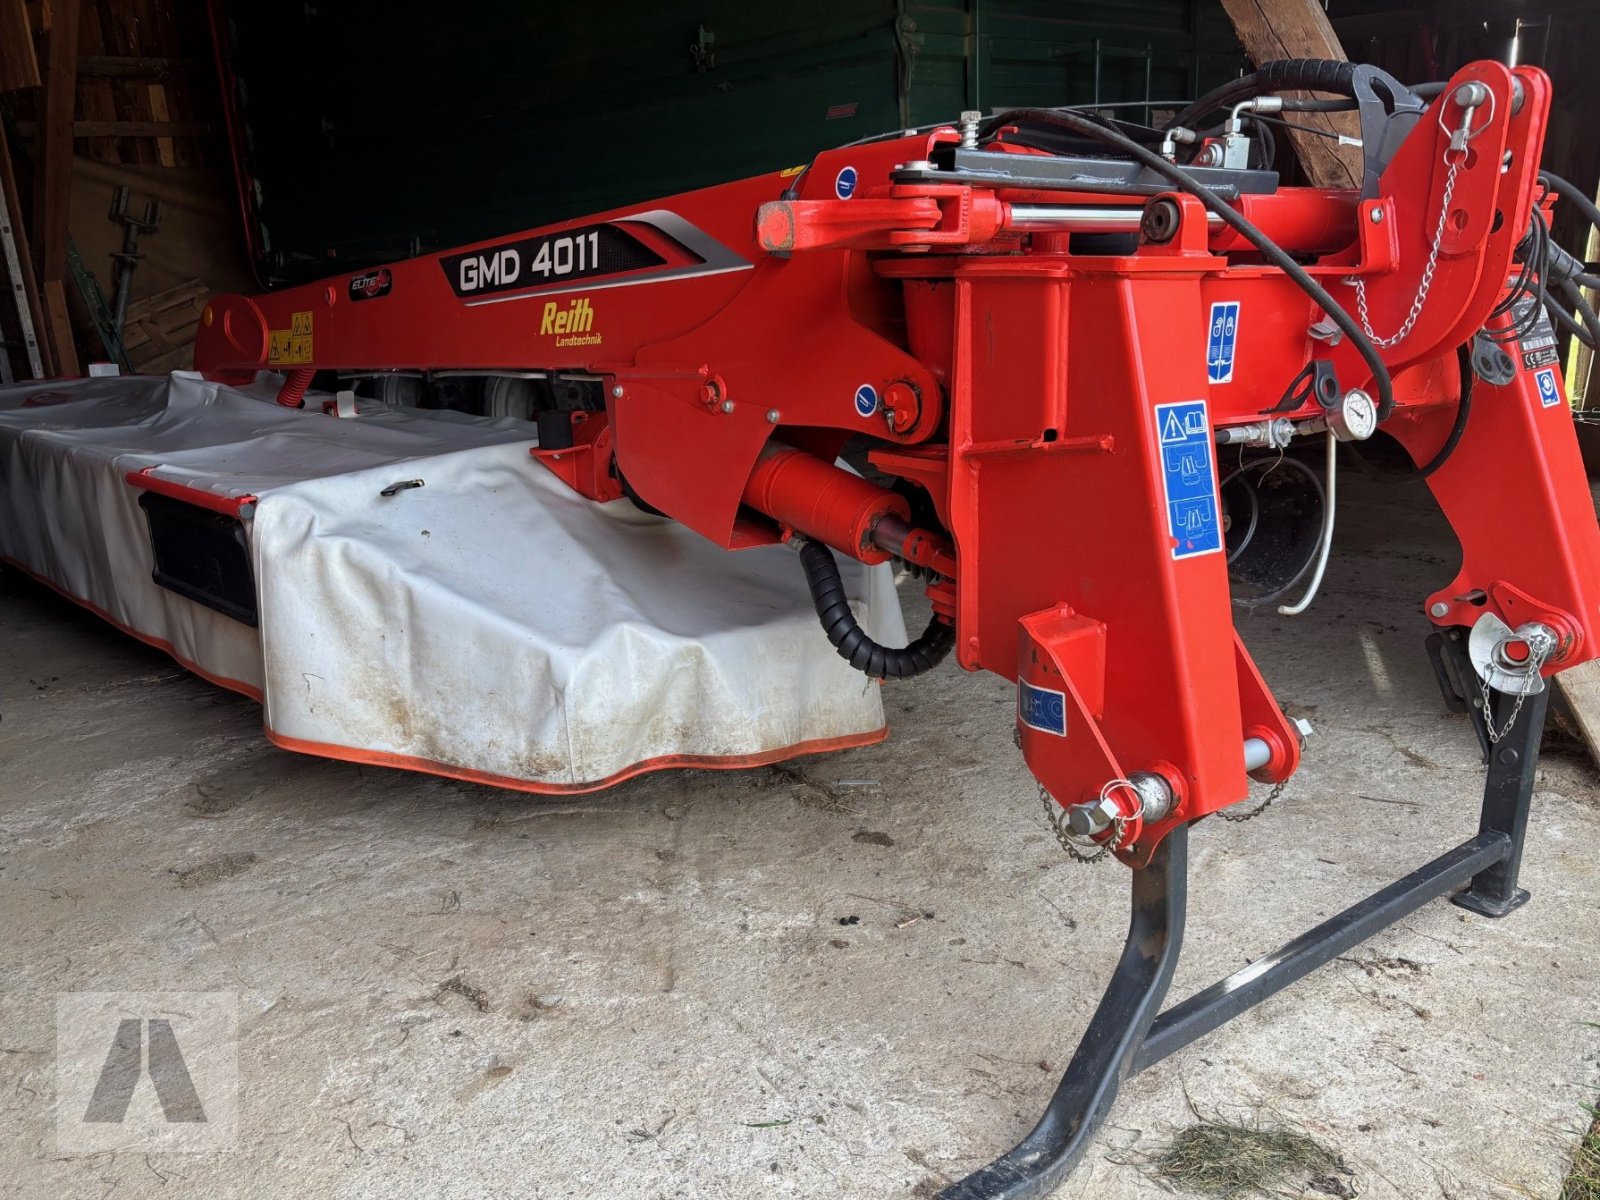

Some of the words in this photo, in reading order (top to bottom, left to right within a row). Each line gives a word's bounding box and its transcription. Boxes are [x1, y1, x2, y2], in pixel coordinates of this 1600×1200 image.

[460, 249, 520, 292] GMD
[532, 231, 600, 277] 4011
[352, 277, 377, 290] ELITE
[540, 298, 594, 335] Reith
[556, 334, 602, 347] Landtechnik
